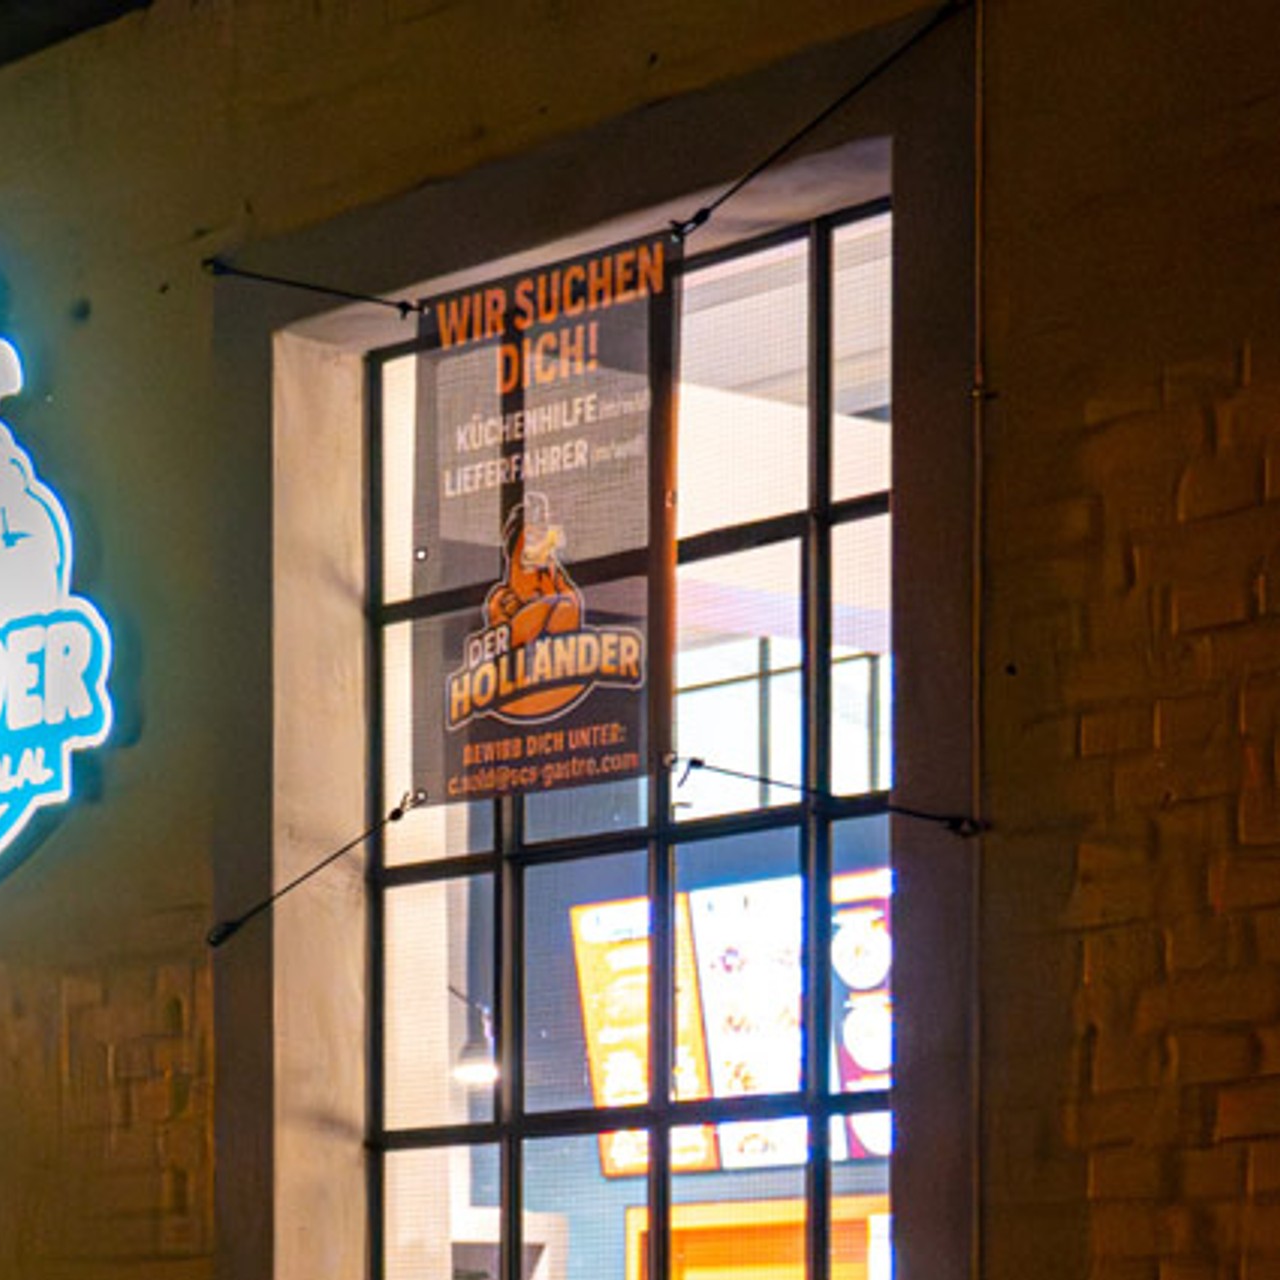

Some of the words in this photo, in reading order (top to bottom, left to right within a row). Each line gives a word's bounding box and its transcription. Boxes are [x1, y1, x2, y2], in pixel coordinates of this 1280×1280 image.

[437, 288, 506, 349] WIR
[514, 243, 664, 331] SUCHEN
[497, 321, 598, 394] DICH!
[468, 624, 509, 668] DER
